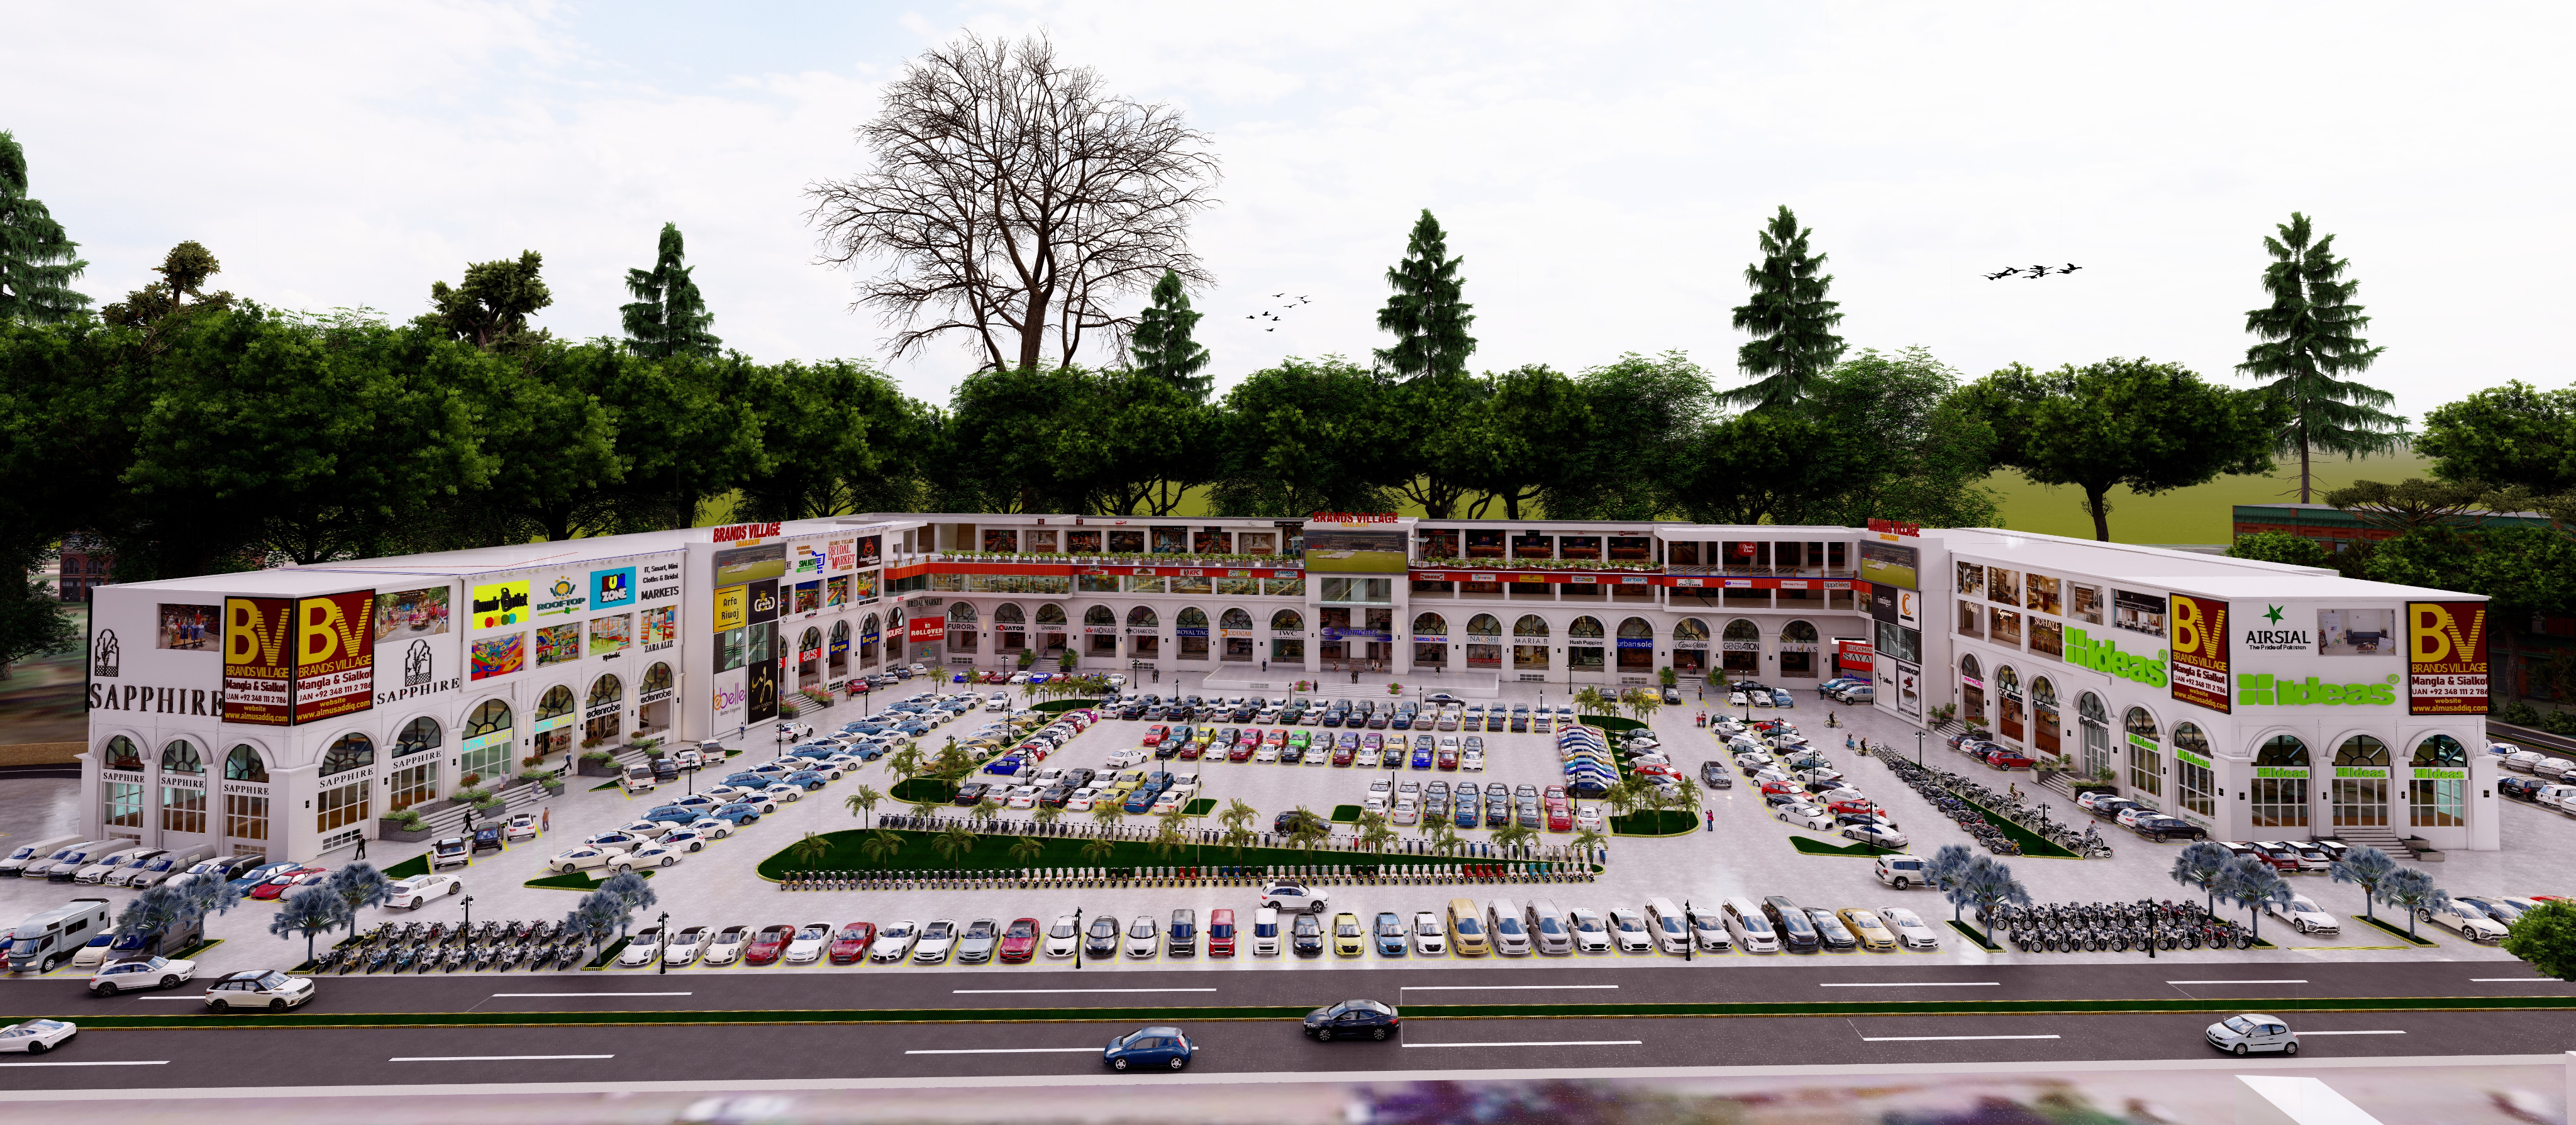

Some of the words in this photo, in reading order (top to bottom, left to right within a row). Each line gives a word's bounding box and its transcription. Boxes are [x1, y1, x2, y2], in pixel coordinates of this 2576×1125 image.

[1313, 511, 1353, 523] BRANDS
[1356, 512, 1398, 523] VILLAGE
[713, 525, 747, 543] BRANDS
[748, 521, 780, 539] VILLAGE
[1867, 518, 1892, 533] BRANDS
[1892, 521, 1919, 537] VILLAGE
[735, 538, 761, 547] SIALKOT
[828, 544, 850, 560] BRIDAL
[799, 558, 816, 567] SIALKOT
[832, 554, 855, 569] MARKET
[602, 574, 626, 590] FUN
[601, 587, 627, 602] ZONE
[641, 586, 679, 601] MARKETS
[1877, 595, 1892, 607] image
[536, 597, 586, 611] ROOFTOP
[723, 597, 737, 607] Arfa
[907, 599, 923, 607] BRIDAL
[924, 597, 943, 606] MARKET
[721, 608, 739, 620] Riwaj
[2035, 617, 2059, 629] SOHAYE
[2172, 595, 2225, 659] BV
[225, 599, 290, 666] BV
[298, 597, 373, 666] BV
[2246, 630, 2311, 644] AIRSIAL
[2411, 604, 2485, 663] BV
[645, 643, 659, 653] ZARA
[660, 640, 673, 649] ALIZ
[1723, 642, 1760, 650] GENERATION
[1782, 644, 1818, 652] ALMAS
[1843, 653, 1871, 662] SAYA
[2086, 638, 2167, 687] Ideas
[2173, 651, 2198, 665] BRANDS
[2199, 657, 2227, 671] VILLAGE
[226, 666, 256, 677] BRANDS
[256, 667, 289, 678] VILLAGE
[299, 662, 334, 677] BRANDS
[335, 655, 372, 670] VILLAGE
[2174, 663, 2195, 677] Mangla
[2196, 669, 2201, 678] &
[2202, 670, 2225, 684] Sialkot
[2412, 663, 2448, 673] BRANDS
[2449, 663, 2487, 673] VILLAGE
[226, 679, 252, 692] Mangla
[253, 681, 259, 691] &
[260, 681, 286, 692] Sialkot
[297, 677, 331, 691] Mangla
[333, 675, 340, 684] &
[342, 669, 372, 682] Sialkot
[1975, 680, 1983, 689] City
[2174, 675, 2185, 683] UAN
[2412, 676, 2445, 687] Mangla
[2448, 676, 2455, 685] &
[2457, 676, 2489, 685] Sialkot
[298, 693, 313, 702] UAN
[315, 690, 327, 698] +92
[330, 687, 342, 696] 348
[360, 682, 372, 690] 786
[377, 677, 460, 705] SAPPHIRE
[640, 689, 672, 704] edenrobe
[2189, 687, 2209, 697] website
[2277, 677, 2396, 706] Ideas
[89, 683, 223, 717] SAPPHIRE
[319, 697, 346, 707] website
[2174, 690, 2228, 710] www.almusaddiq.com
[296, 700, 370, 721] www.almusaddiq.com
[586, 703, 621, 719] edenrobe
[2412, 704, 2488, 712] www.almusaddiq.com
[225, 712, 288, 723] www.almusaddiq.com
[535, 713, 575, 732] LIMELIGHT
[2079, 716, 2109, 734] Outfitters
[464, 729, 513, 751] LIMELIGHT
[2137, 736, 2158, 751] Ideas
[393, 750, 441, 769] SAPPHIRE
[2186, 751, 2210, 769] Ideas
[103, 772, 145, 783] SAPPHIRE
[319, 767, 374, 788] SAPPHIRE
[2272, 768, 2308, 779] Ideas
[2350, 768, 2386, 779] Ideas
[2428, 768, 2465, 779] Ideas
[162, 777, 204, 789] SAPPHIRE
[224, 784, 269, 795] SAPPHIRE
